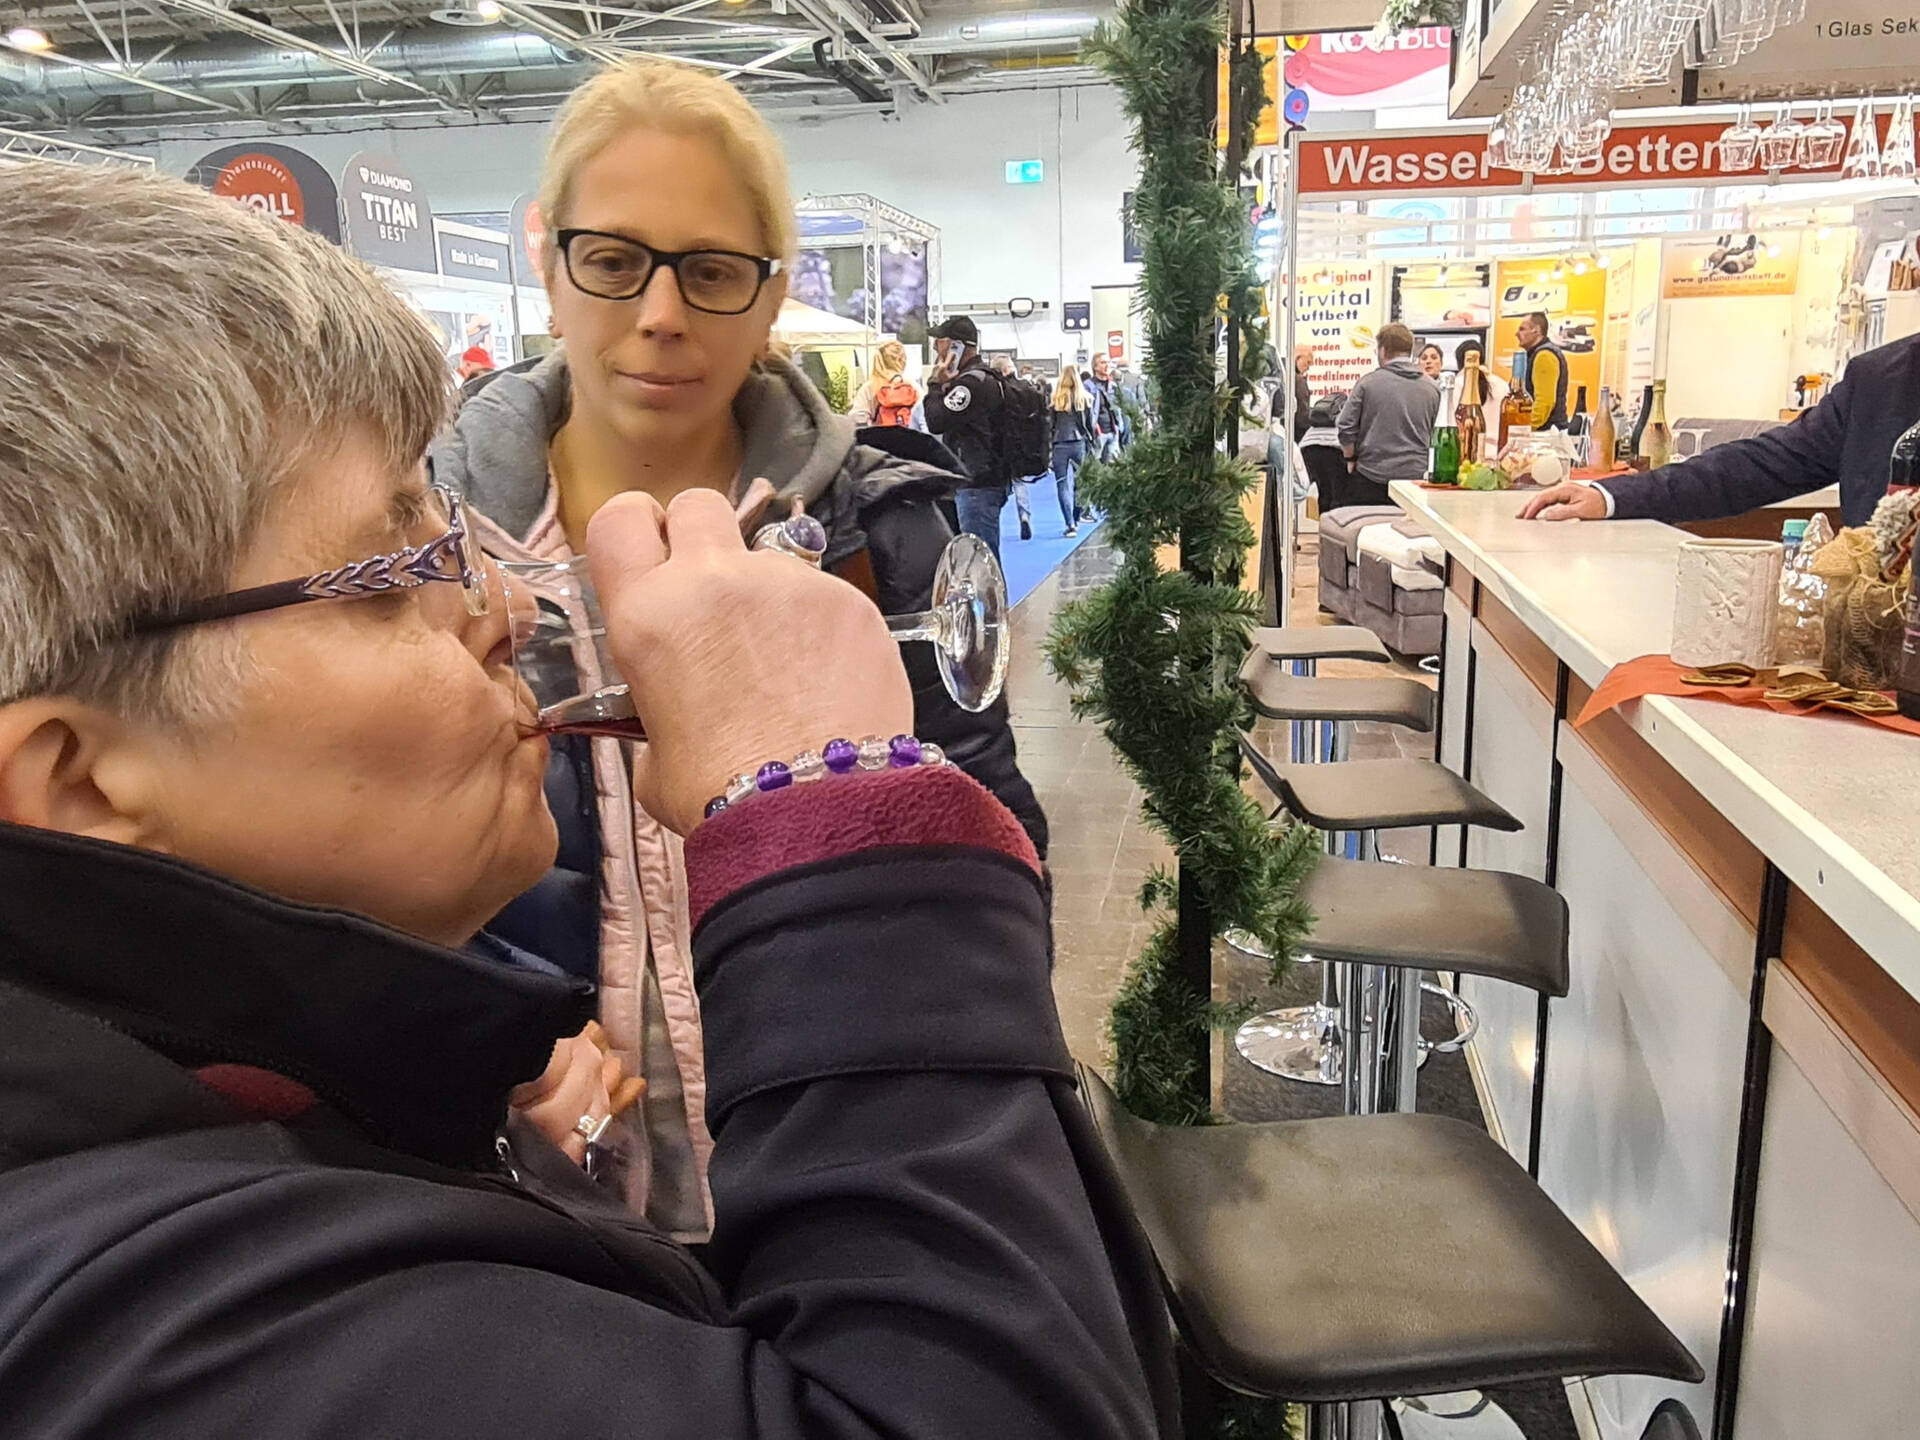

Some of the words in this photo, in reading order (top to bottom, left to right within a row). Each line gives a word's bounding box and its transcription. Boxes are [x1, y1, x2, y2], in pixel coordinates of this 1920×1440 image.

[1815, 24, 1821, 37] 1
[1828, 21, 1873, 38] Glas
[1881, 18, 1918, 35] Sek
[370, 171, 412, 193] DIAMOND
[379, 225, 407, 243] BEST
[1313, 269, 1371, 286] Oiginal
[1312, 327, 1341, 336] von
[1312, 356, 1372, 368] therapeuten
